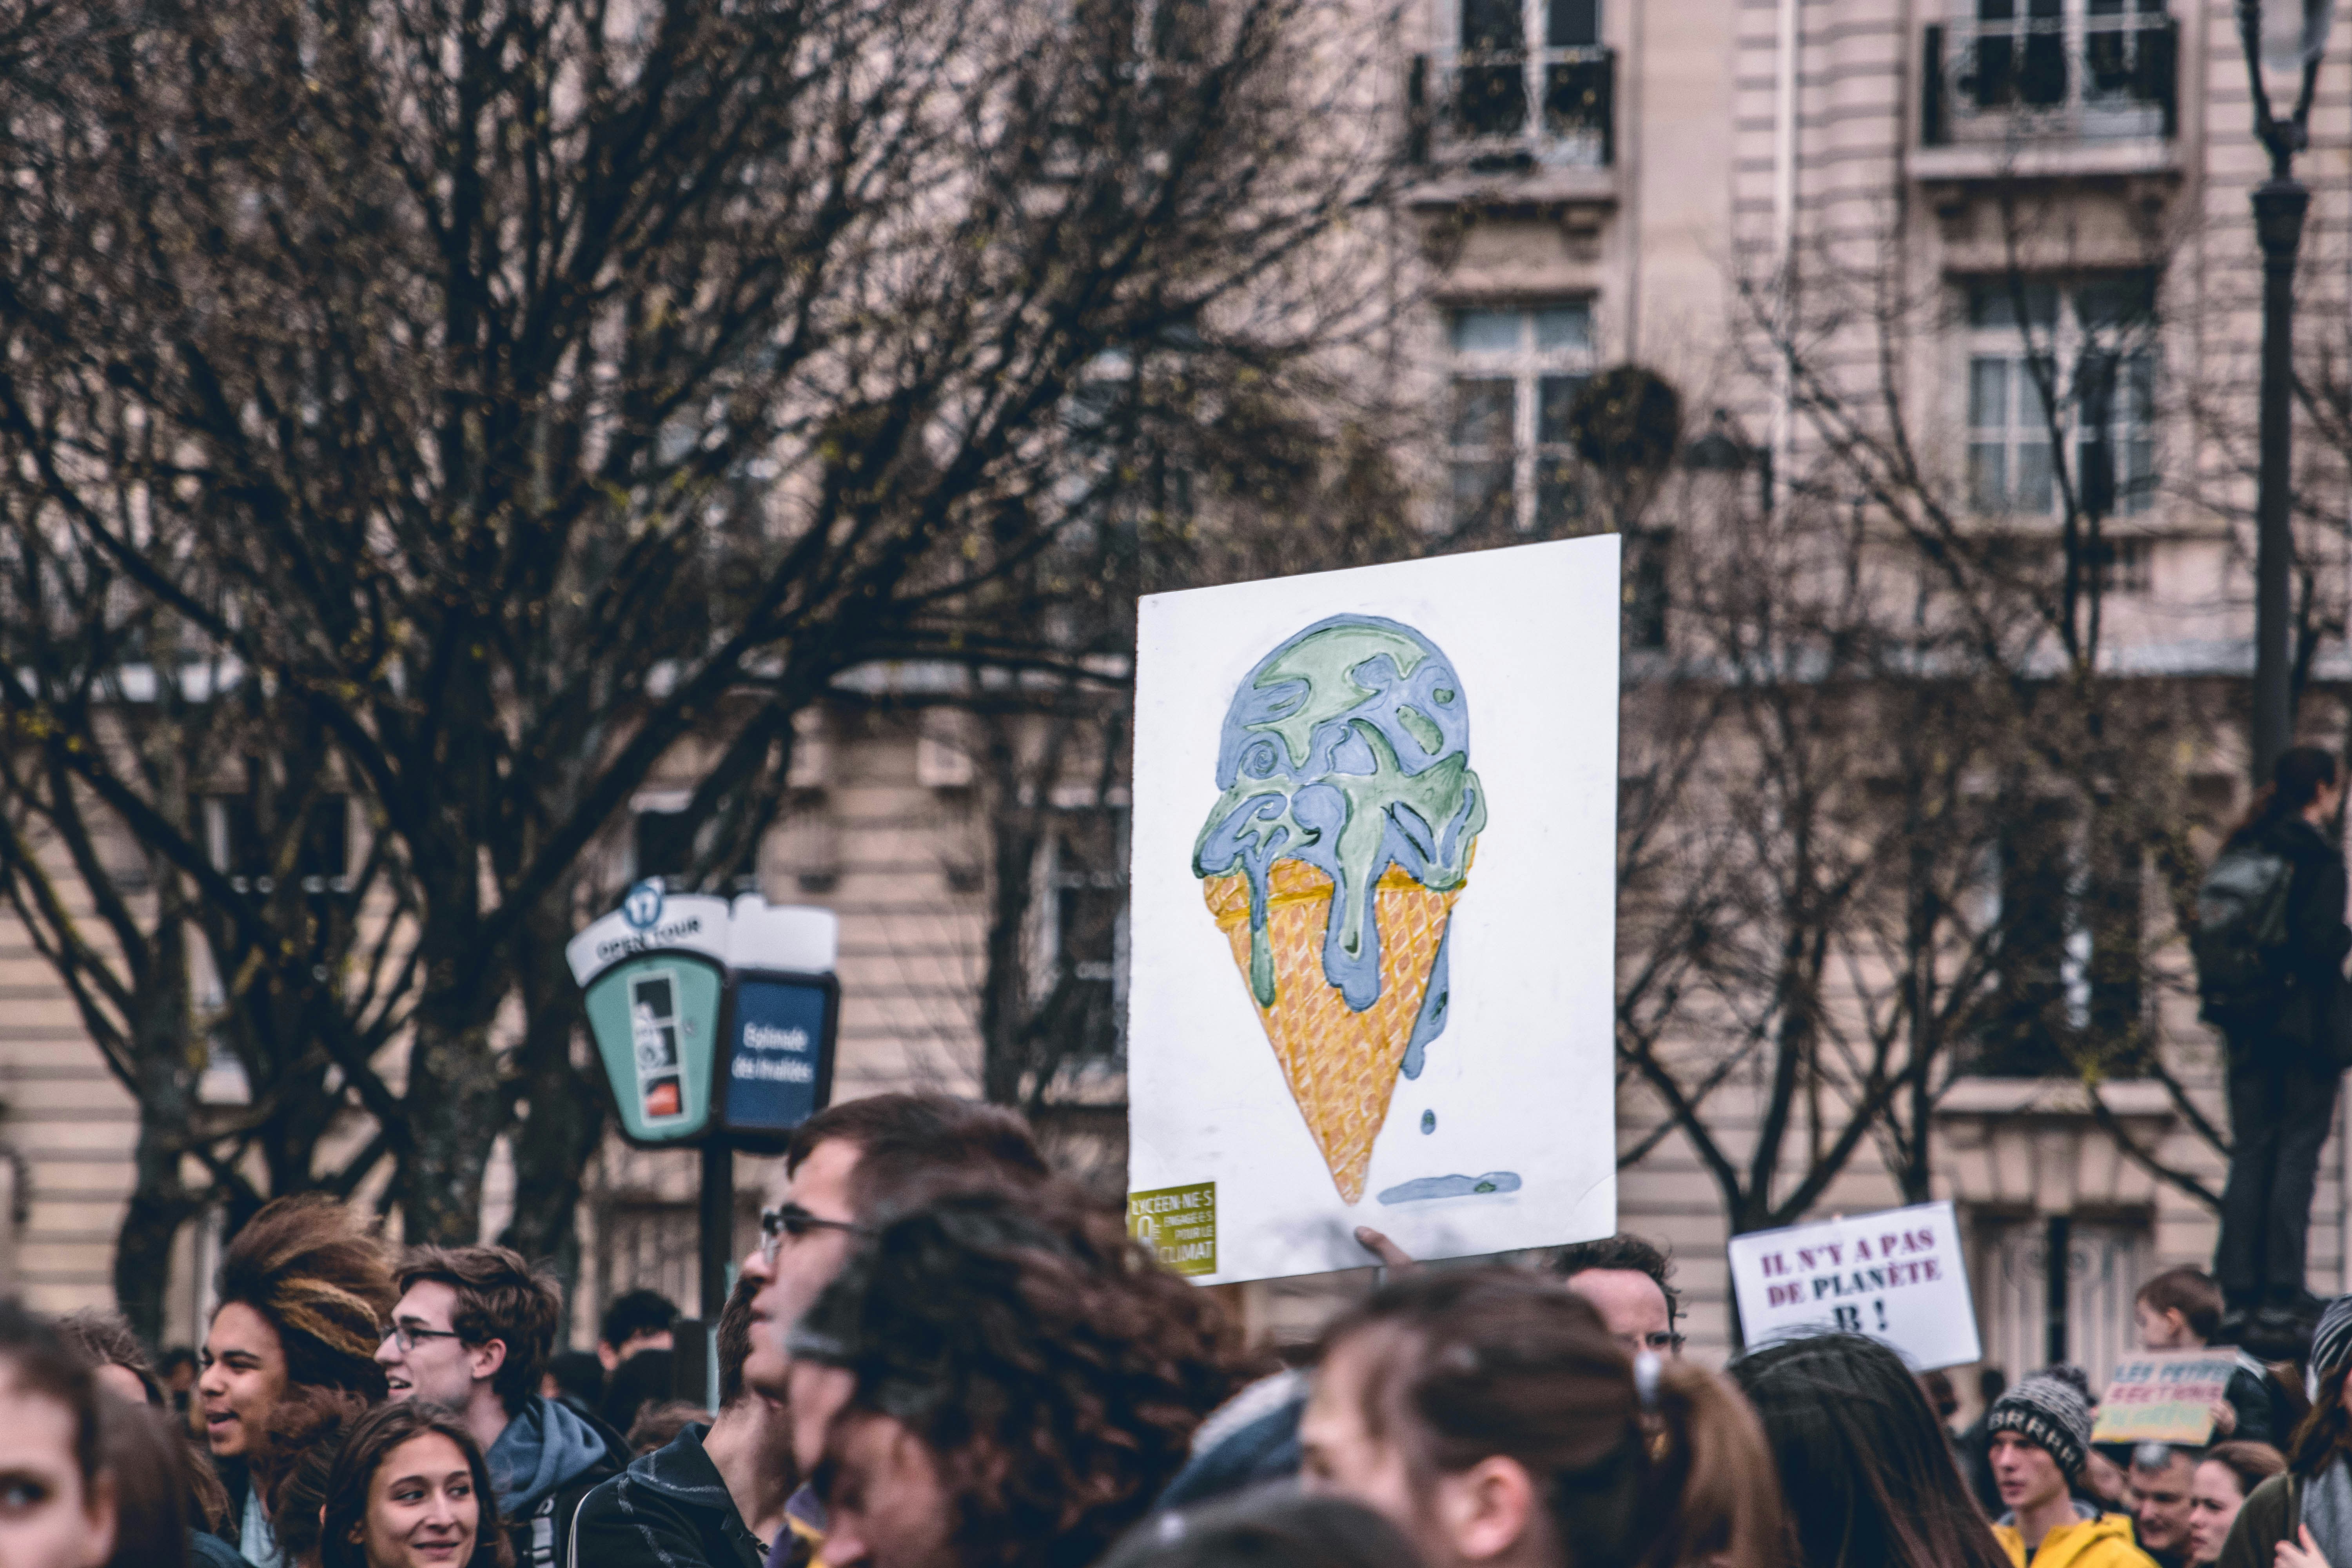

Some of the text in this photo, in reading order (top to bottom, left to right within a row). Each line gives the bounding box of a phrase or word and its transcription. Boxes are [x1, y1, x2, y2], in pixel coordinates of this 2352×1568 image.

[1159, 1241, 1214, 1263] CLIMAT
[1760, 1228, 1936, 1278] IL N'Y A PAS
[1767, 1258, 1942, 1308] DE PLANÈTE
[1833, 1303, 1862, 1333] B
